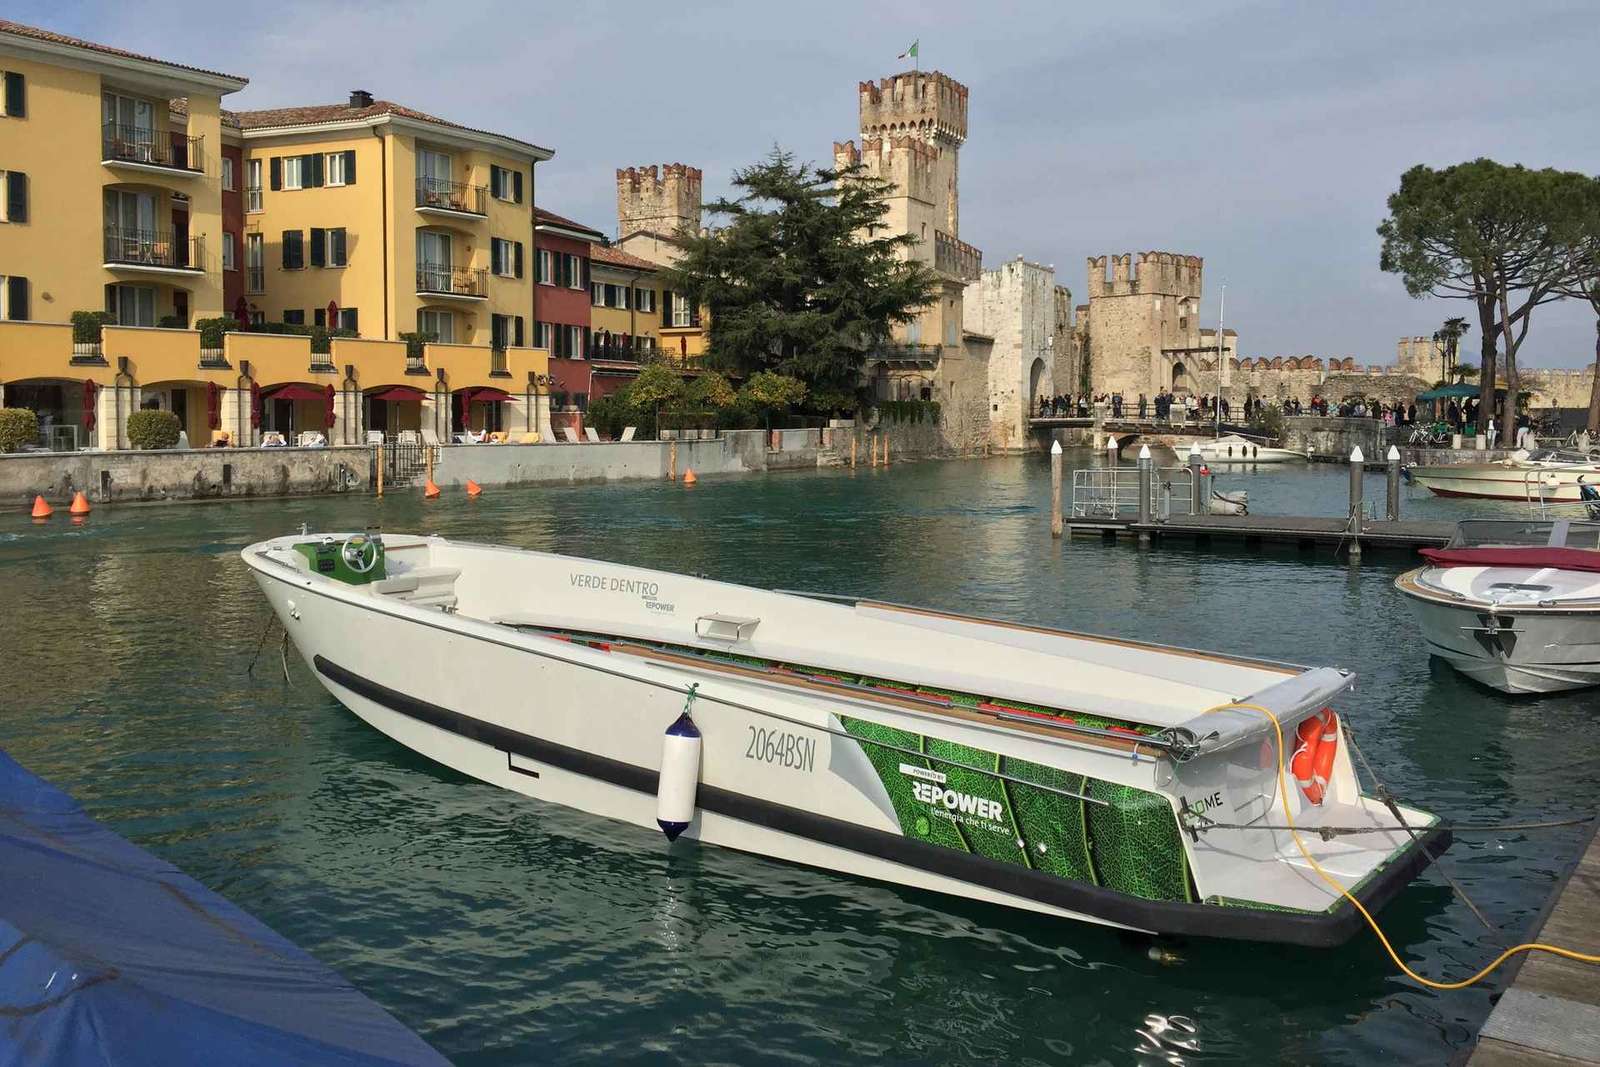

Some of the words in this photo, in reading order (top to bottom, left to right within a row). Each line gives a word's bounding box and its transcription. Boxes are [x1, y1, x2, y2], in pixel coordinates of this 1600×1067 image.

[569, 573, 607, 590] VERDE
[610, 578, 659, 596] DENTRO
[745, 725, 816, 773] 2064BSN
[912, 781, 1003, 822] REPOWER
[965, 817, 980, 827] che
